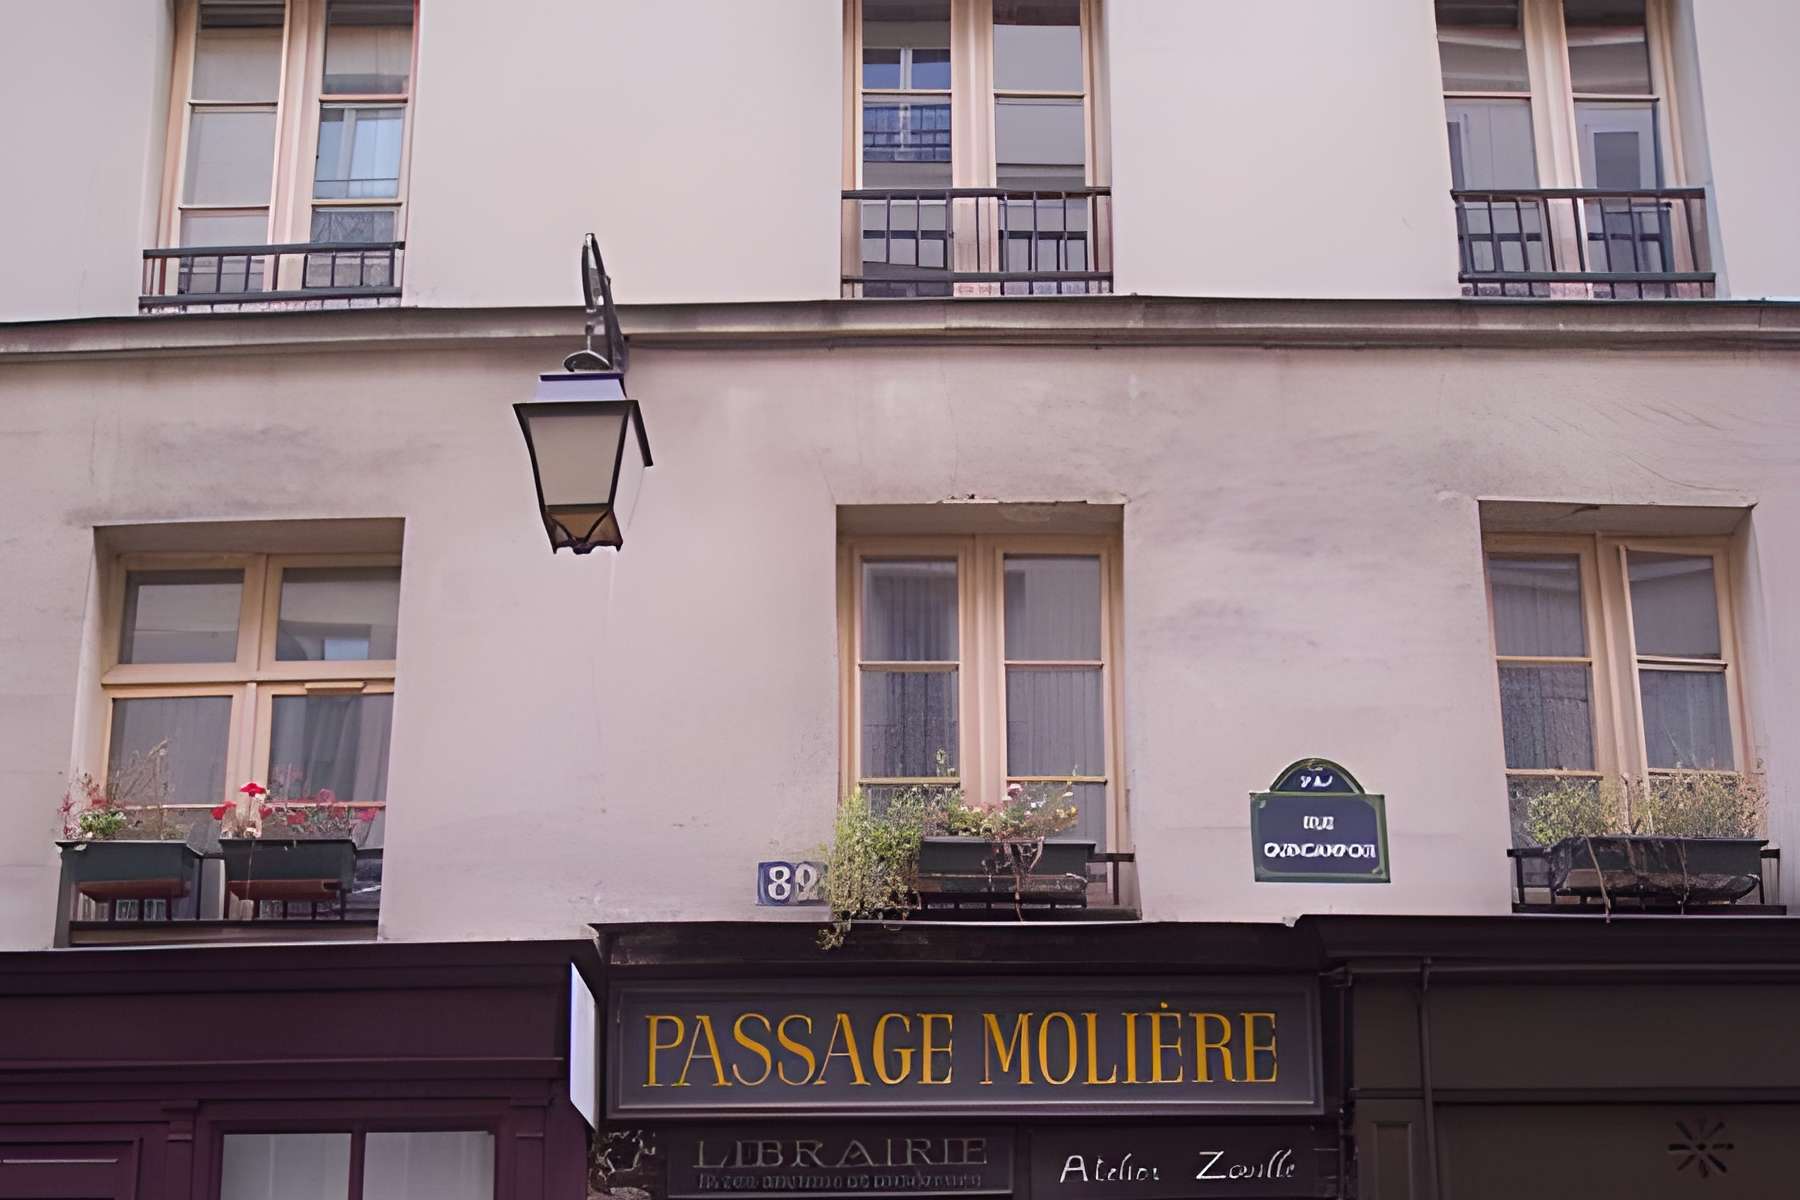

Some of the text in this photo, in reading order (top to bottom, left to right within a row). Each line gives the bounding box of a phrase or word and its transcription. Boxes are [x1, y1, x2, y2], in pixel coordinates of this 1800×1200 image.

[642, 1001, 1279, 1088] PASSAGE MOLIÈRE
[693, 1138, 988, 1168] LIBRAIRIE
